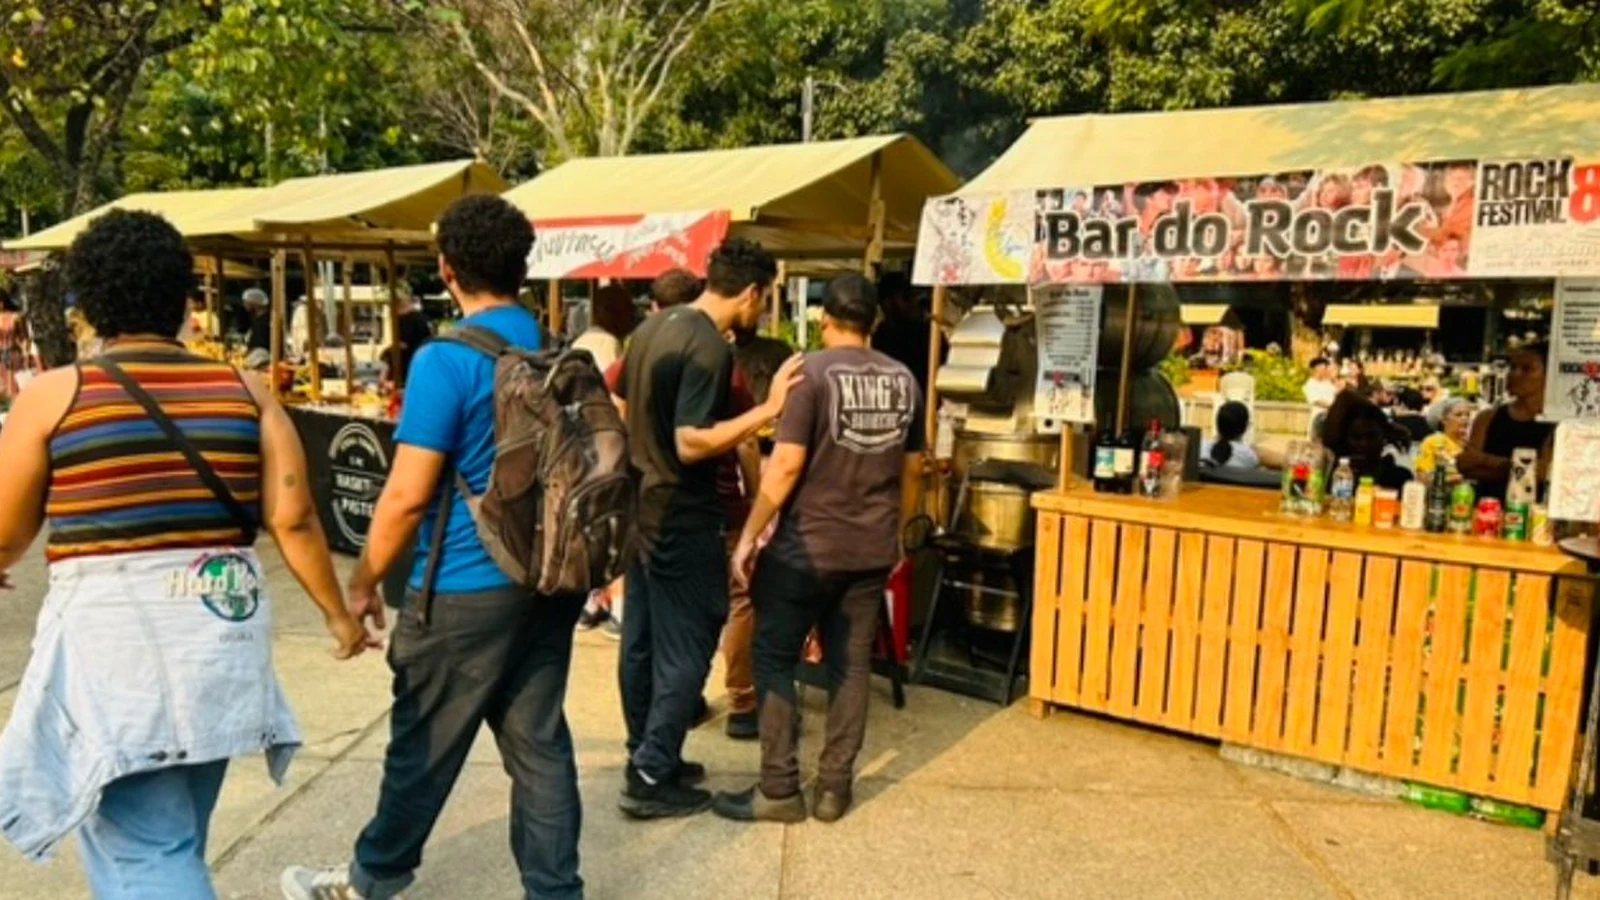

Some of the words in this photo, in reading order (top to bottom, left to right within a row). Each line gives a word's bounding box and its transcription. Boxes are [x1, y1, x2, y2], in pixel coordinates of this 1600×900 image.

[1480, 158, 1573, 201] ROCK
[1045, 211, 1138, 259] Bar
[1153, 199, 1228, 258] do
[1247, 189, 1427, 257] Rock
[1477, 199, 1567, 228] FESTIVAL
[838, 373, 909, 411] KING'S
[163, 566, 229, 598] Hard
